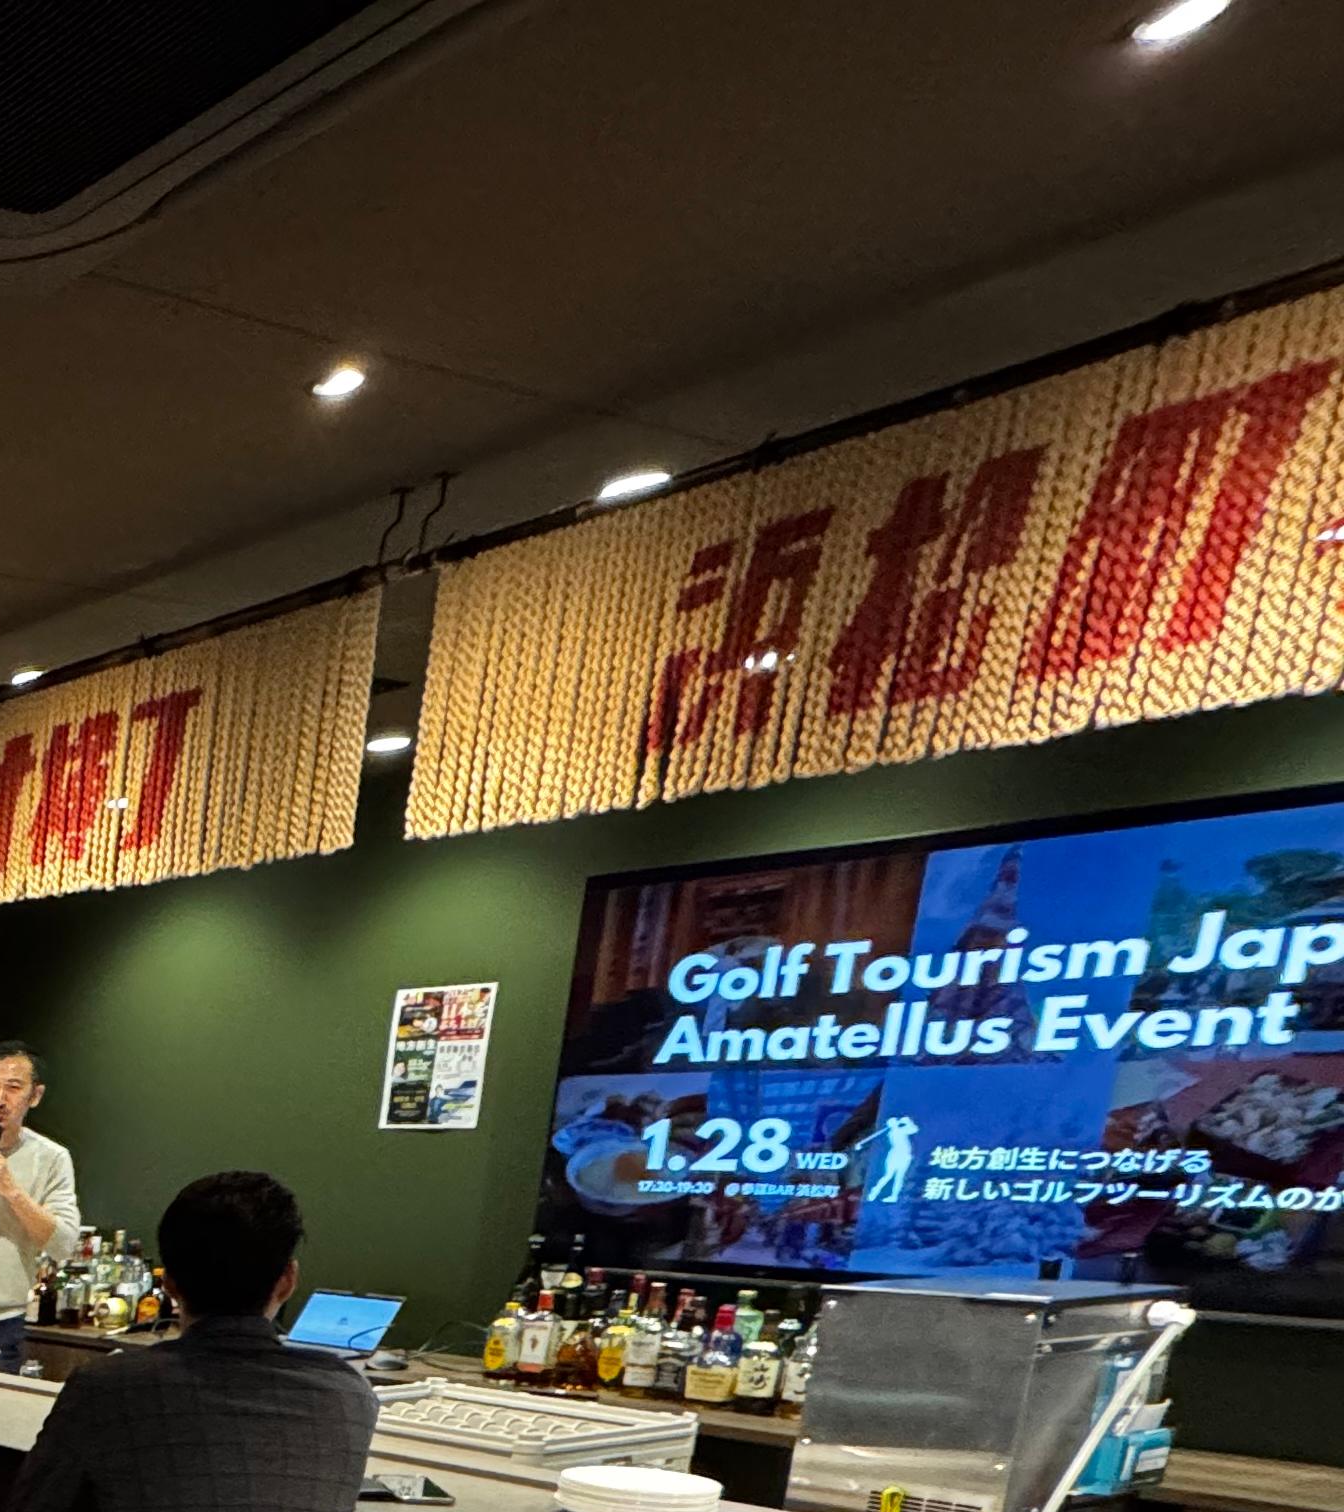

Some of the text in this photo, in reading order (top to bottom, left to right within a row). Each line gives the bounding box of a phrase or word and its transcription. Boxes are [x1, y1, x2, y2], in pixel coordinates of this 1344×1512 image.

[648, 356, 1344, 752] 浜松町
[668, 909, 1344, 1004] Golf Tourism Jap
[652, 991, 1300, 1065] Amatellus Event
[641, 1117, 848, 1173] 1.28 WED
[928, 1146, 1212, 1174] 地方創生につなげる
